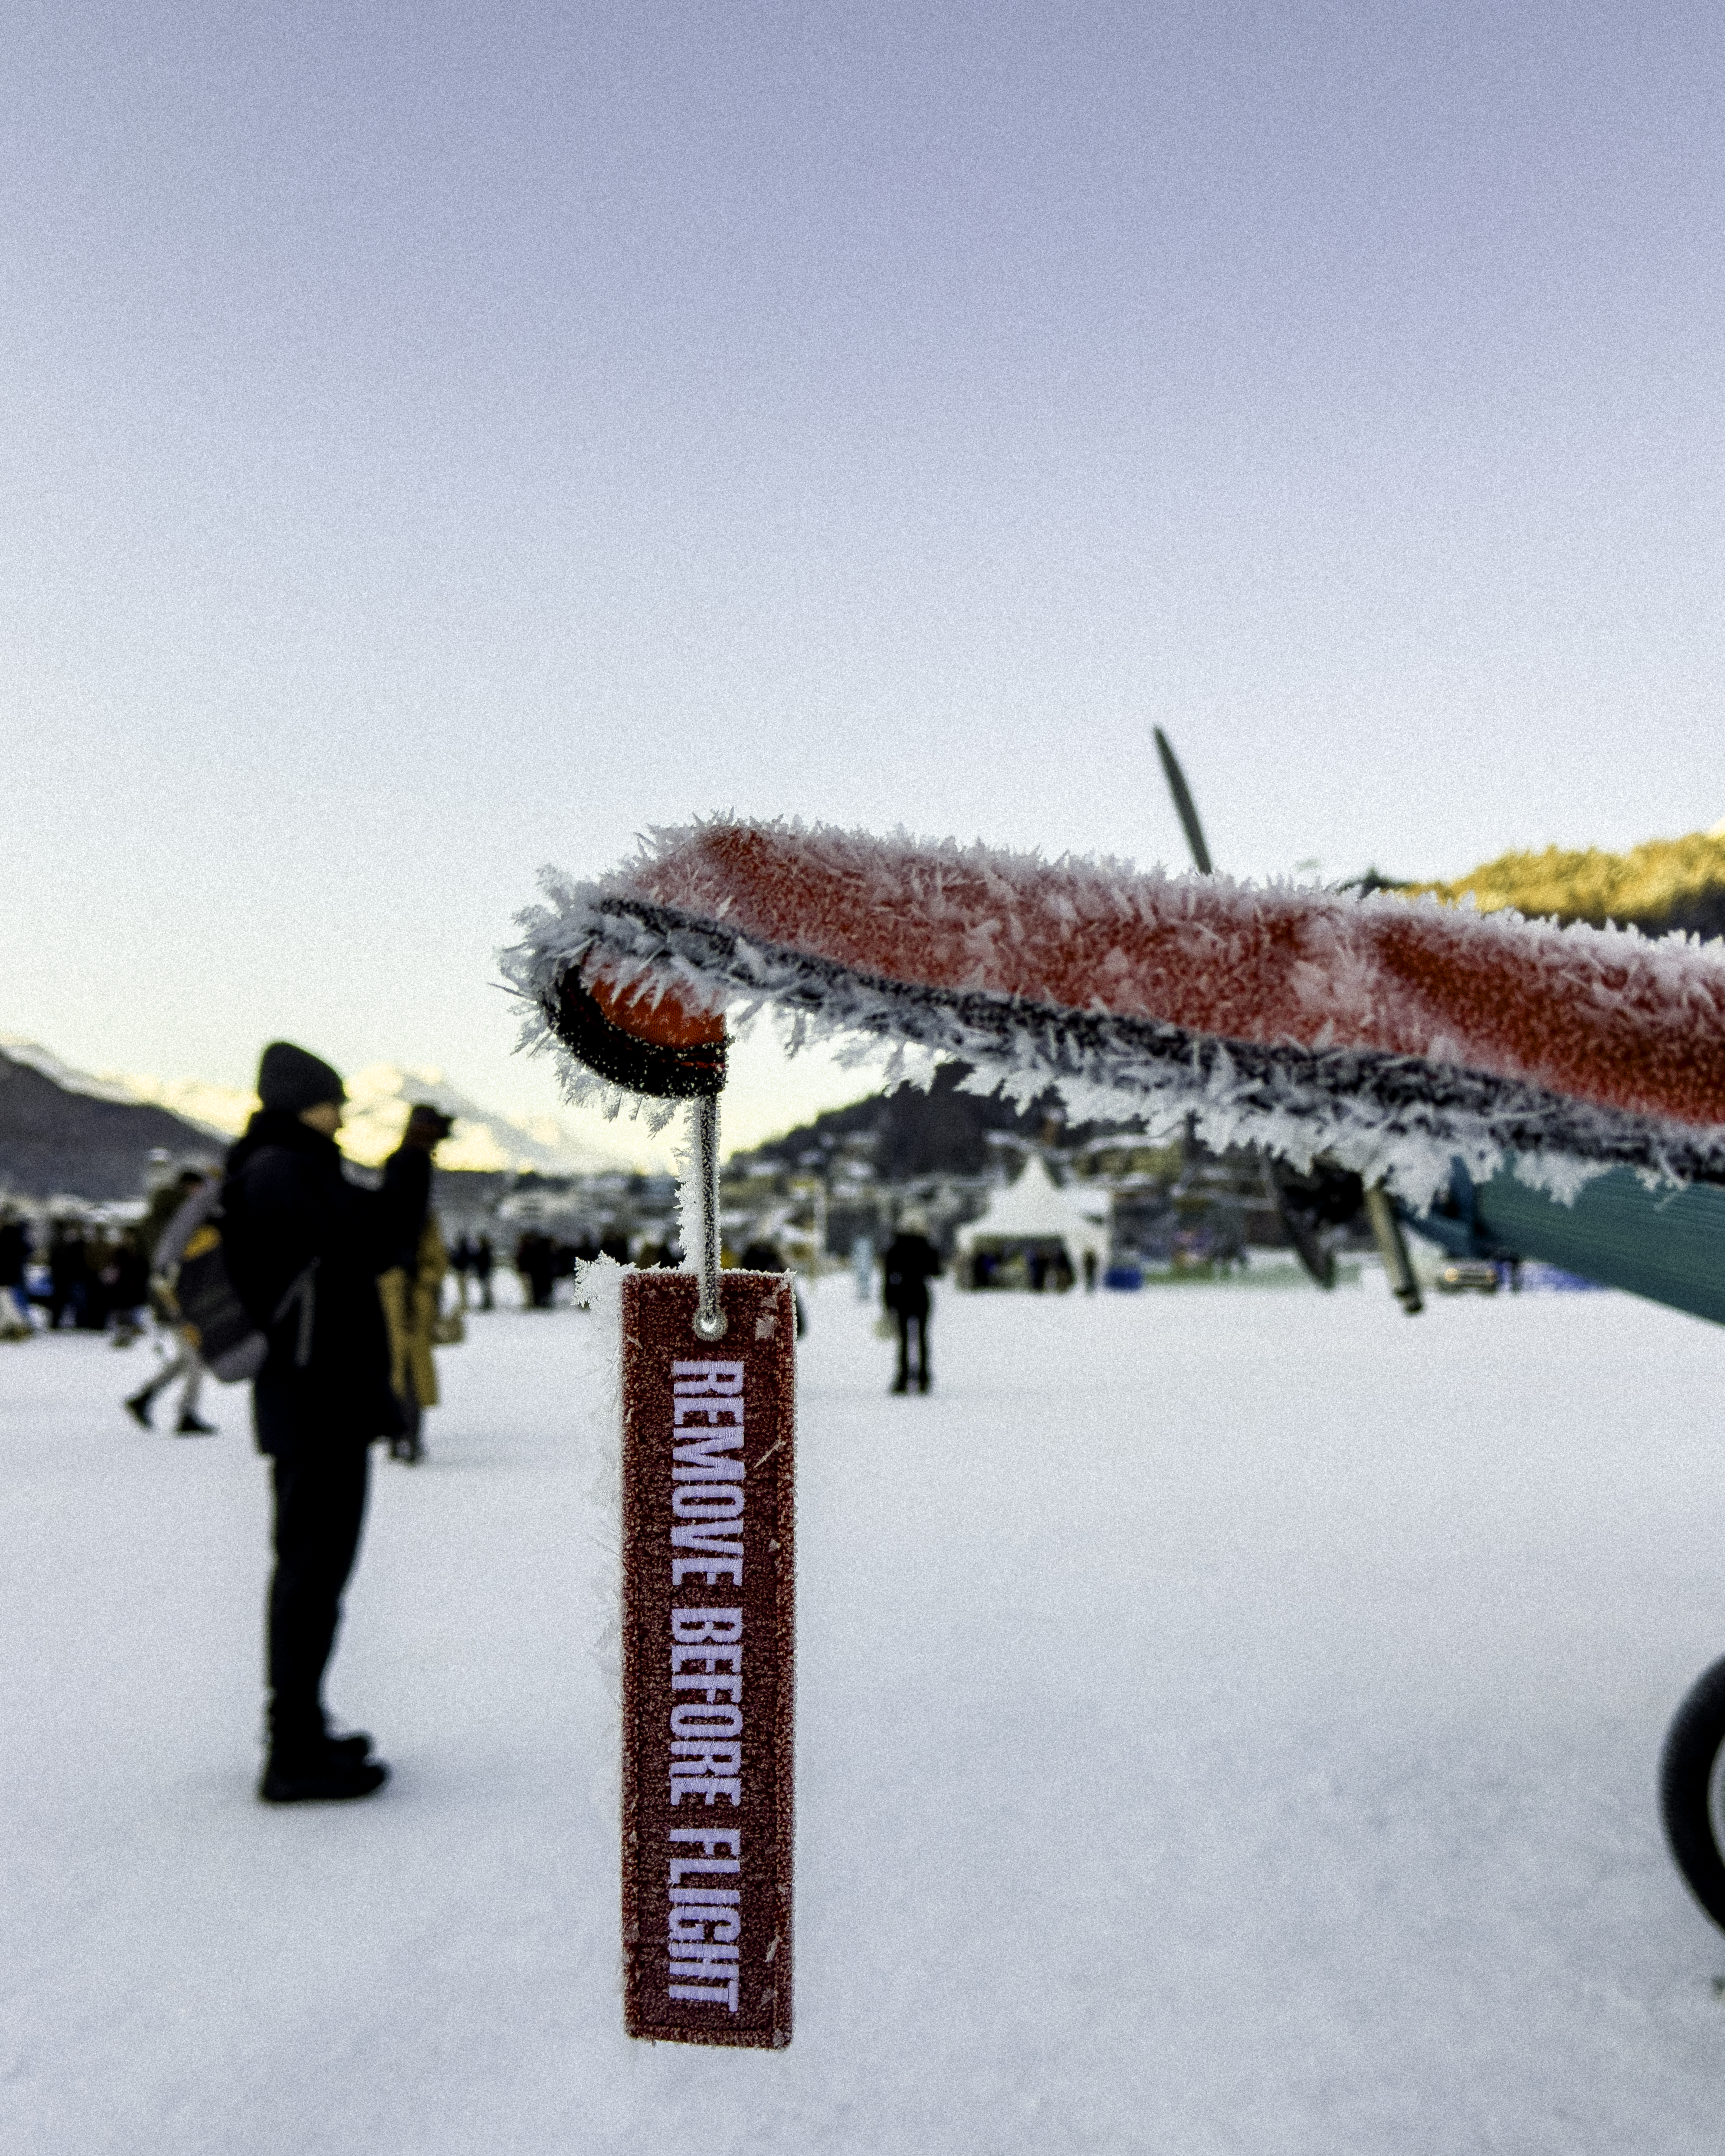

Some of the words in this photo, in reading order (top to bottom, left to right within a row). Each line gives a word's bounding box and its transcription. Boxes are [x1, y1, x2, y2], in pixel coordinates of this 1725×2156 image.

[671, 1360, 745, 1586] REMOVE
[669, 1608, 743, 1805] BEFORE
[668, 1828, 741, 2013] FLIGHT
